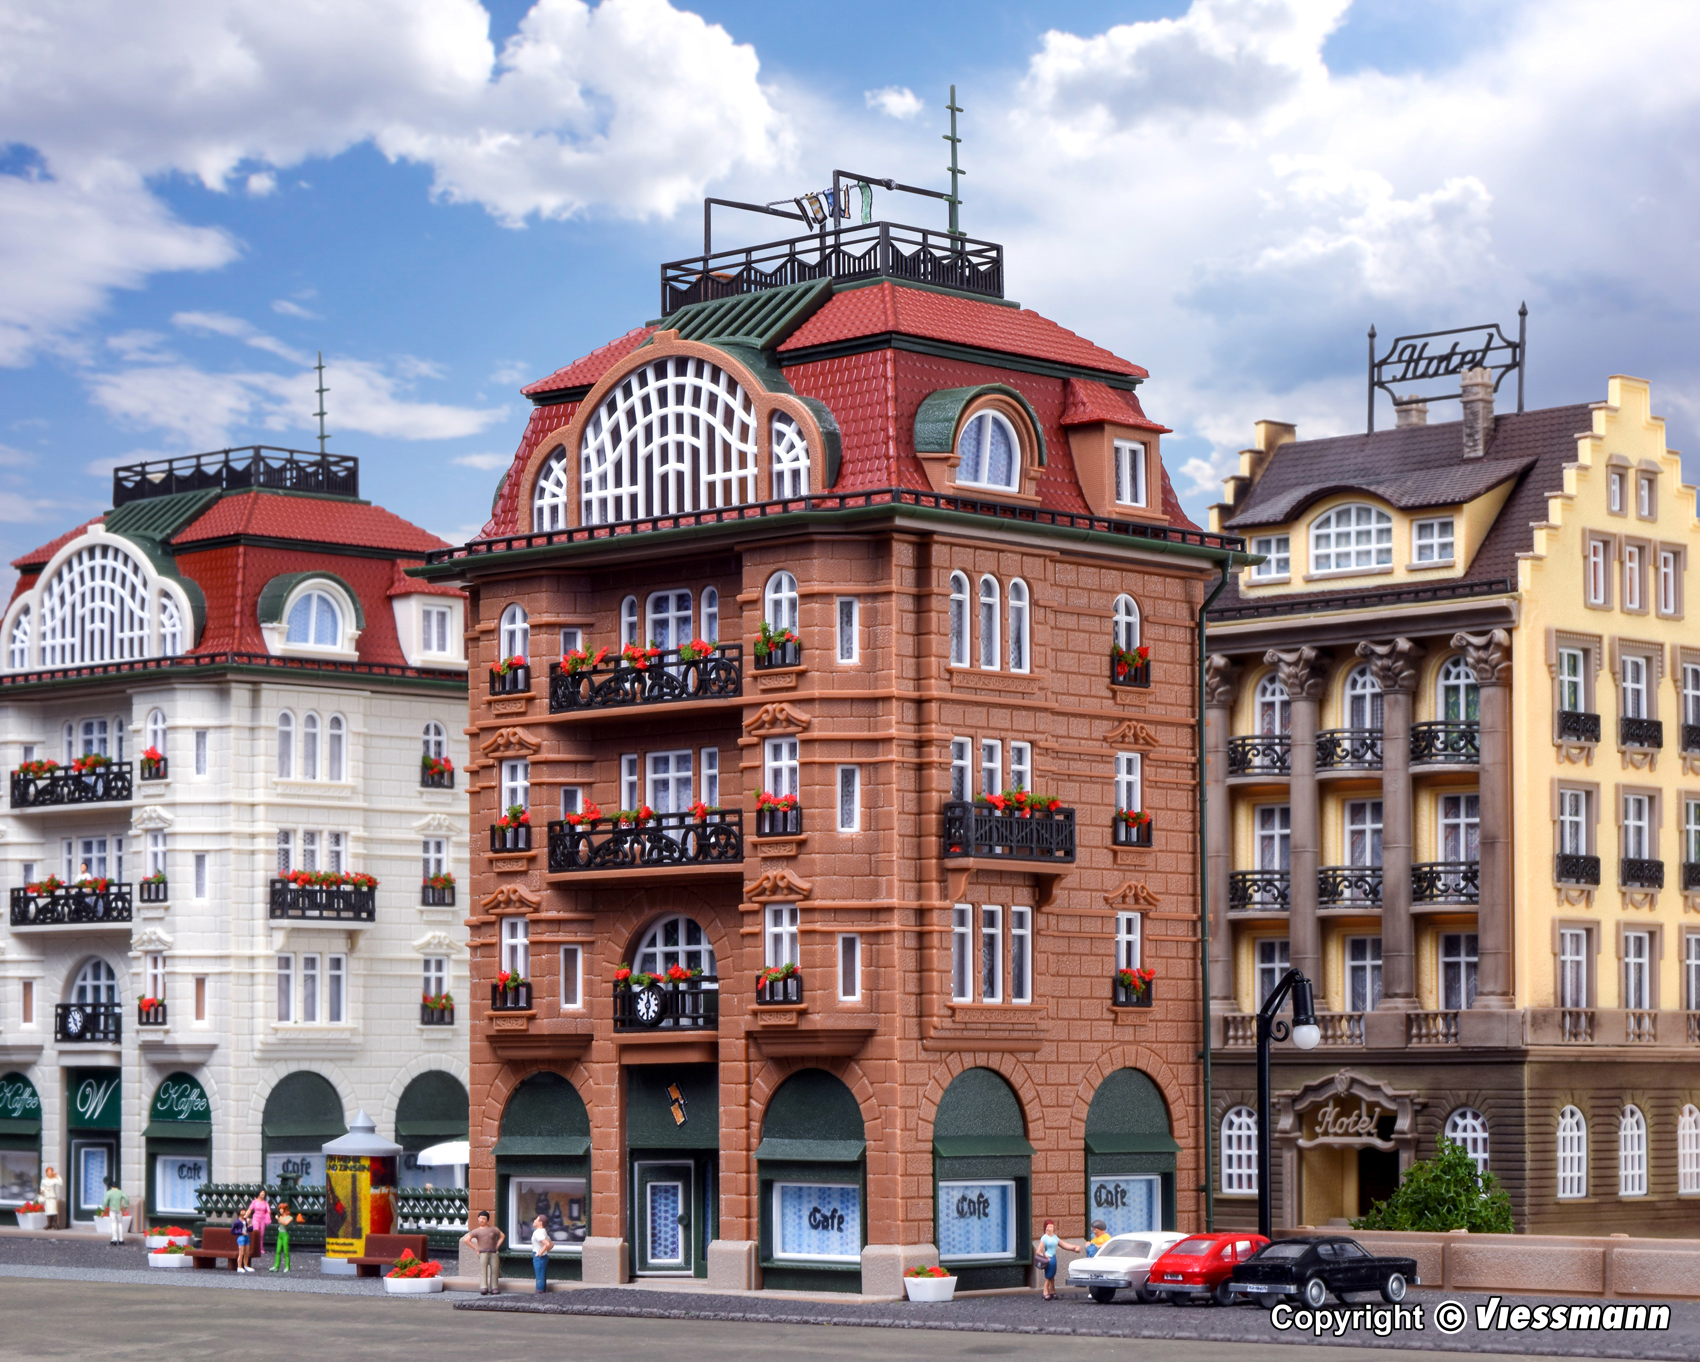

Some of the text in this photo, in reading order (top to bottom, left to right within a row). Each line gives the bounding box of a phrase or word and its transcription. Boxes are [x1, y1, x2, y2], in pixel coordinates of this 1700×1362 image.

[1392, 332, 1494, 380] Hotel
[77, 1078, 119, 1120] W
[157, 1081, 207, 1119] Kaffee
[1314, 1107, 1381, 1134] Hotel
[956, 1192, 990, 1220] Cafe
[1094, 1183, 1127, 1210] Cafe
[808, 1206, 845, 1233] Cafe
